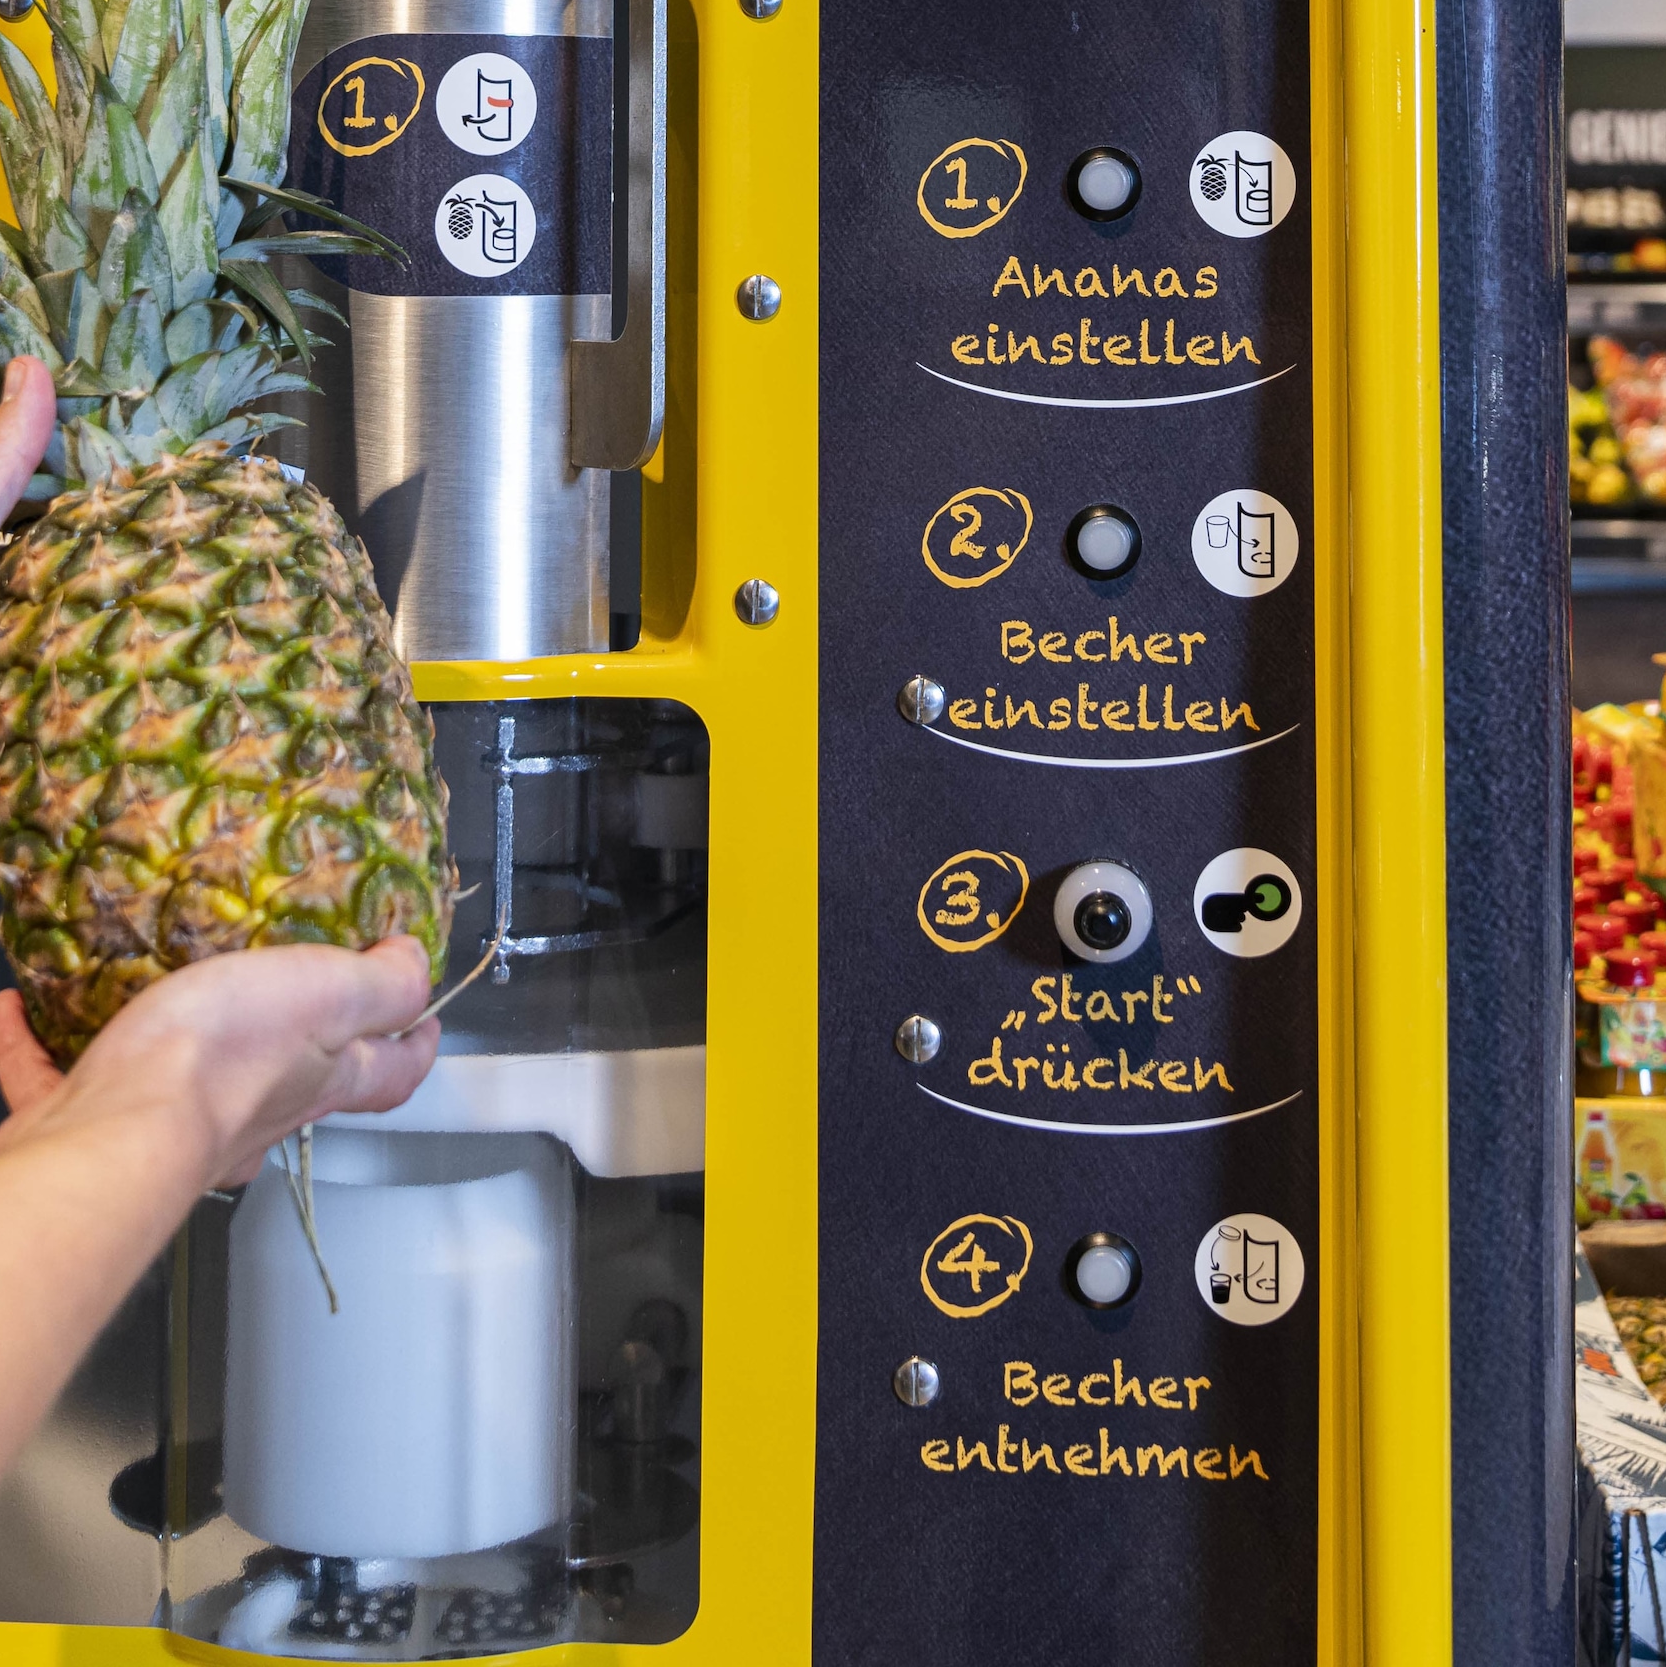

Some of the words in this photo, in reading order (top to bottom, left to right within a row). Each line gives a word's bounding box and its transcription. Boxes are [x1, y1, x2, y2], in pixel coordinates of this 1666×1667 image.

[343, 75, 399, 133] 1.
[944, 156, 1001, 214] 1.
[992, 255, 1219, 300] Ananas
[950, 318, 1262, 367] einstellen
[949, 502, 1011, 561] 2.
[1000, 616, 1207, 666] Becher
[948, 683, 1260, 735] einstellen
[935, 870, 1001, 930] 3.
[966, 1035, 1235, 1093] drücken
[936, 1231, 1022, 1294] 4.
[1003, 1358, 1212, 1412] Becher
[920, 1424, 1270, 1481] entnehmen
